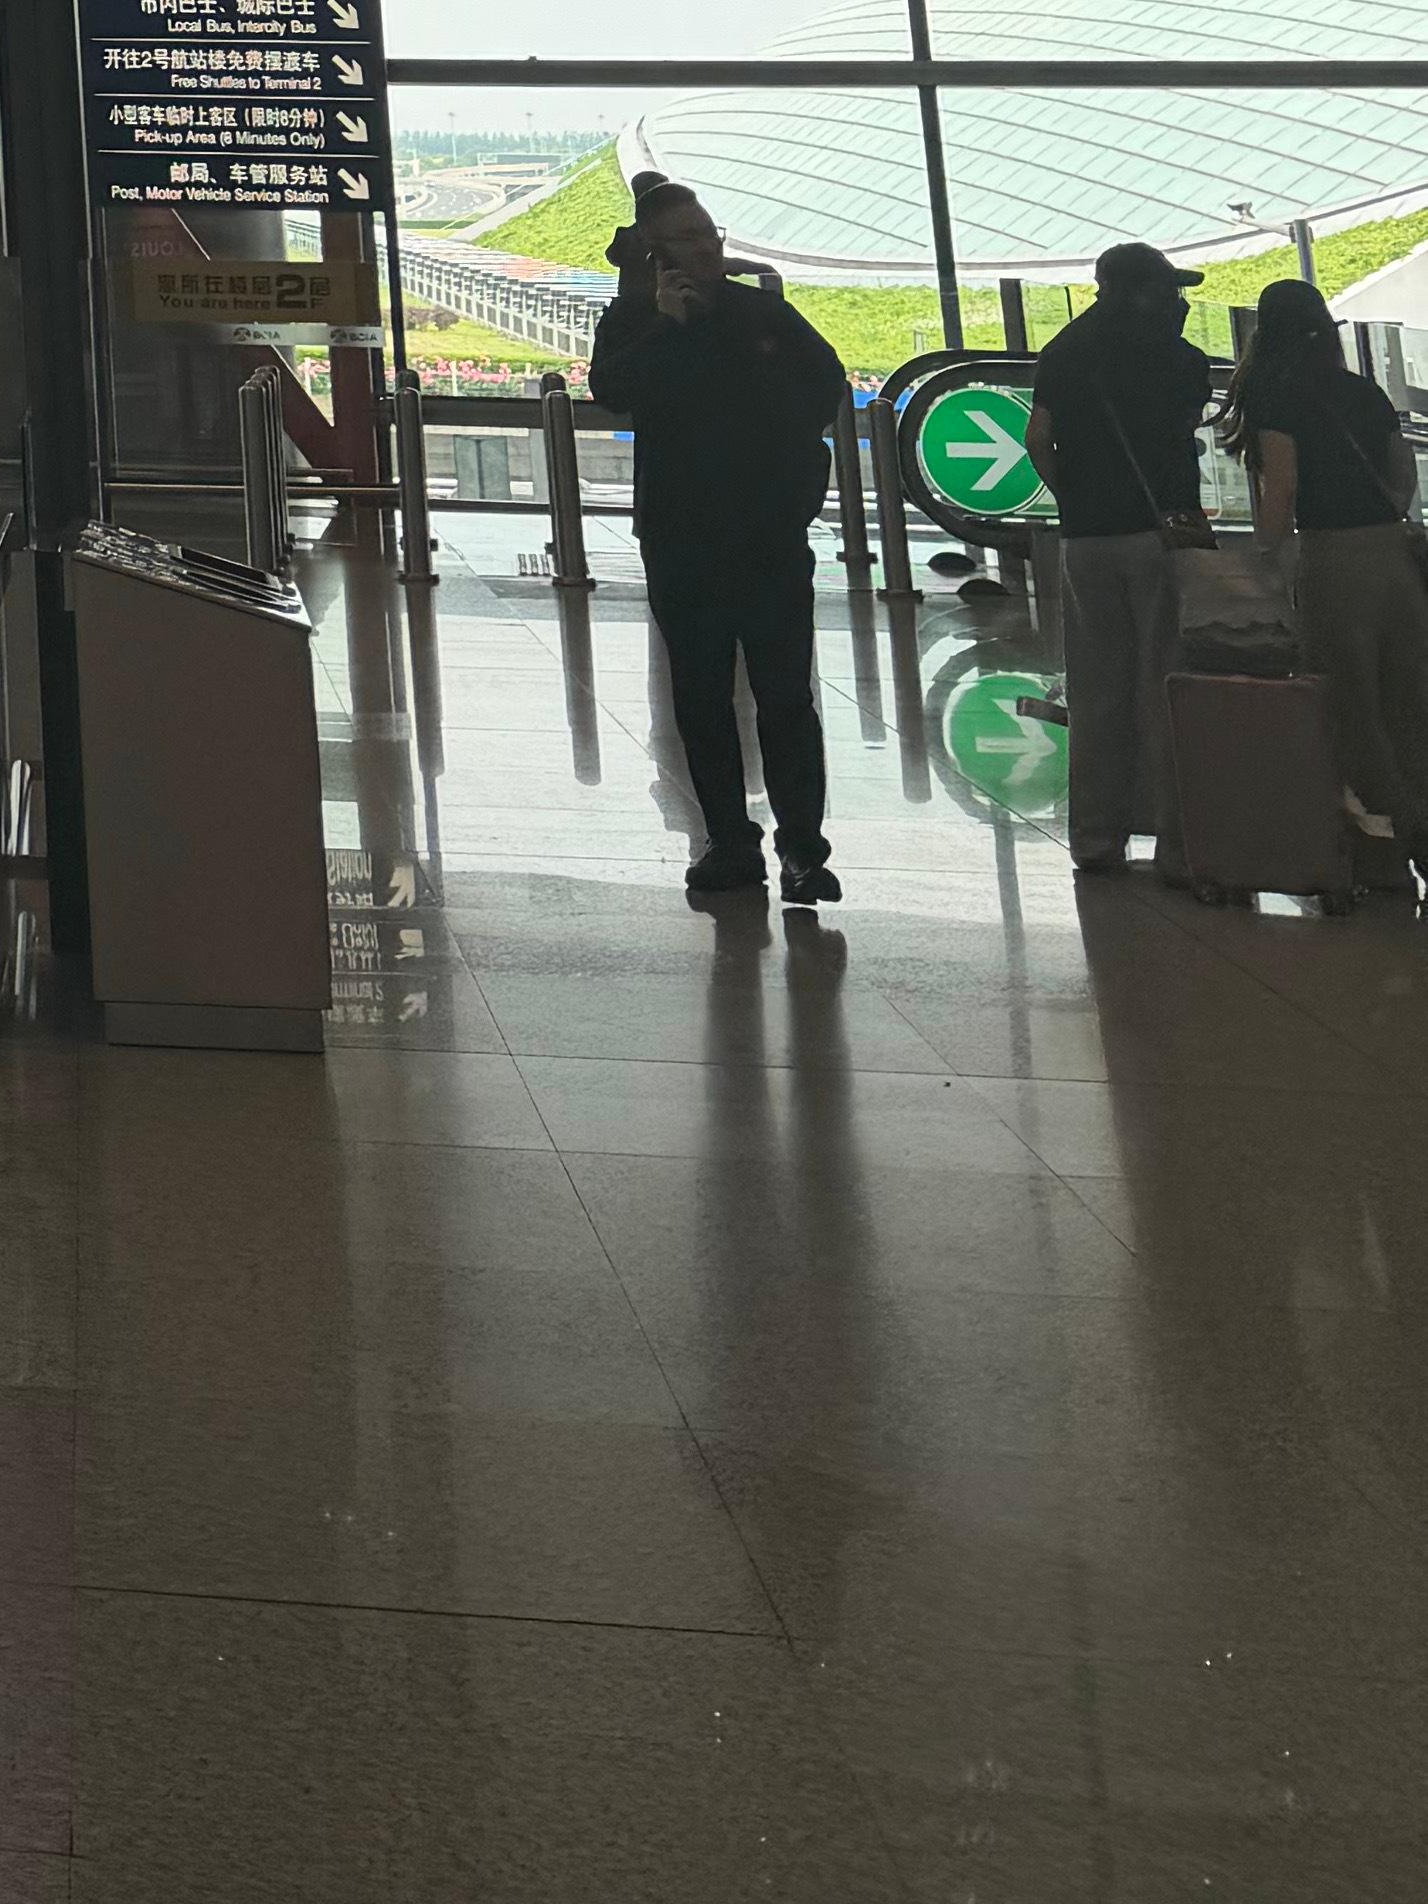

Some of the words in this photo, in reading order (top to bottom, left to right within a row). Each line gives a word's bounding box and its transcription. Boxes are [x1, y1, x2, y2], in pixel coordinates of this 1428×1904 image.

[167, 19, 202, 33] Local
[206, 19, 235, 34] Bus,
[238, 19, 286, 36] Intercity
[290, 20, 317, 34] Bus
[103, 49, 321, 72] 开往2号航站楼免费摆渡车
[171, 74, 197, 88] Free
[199, 74, 246, 90] Shuttles
[248, 76, 260, 90] to
[262, 76, 311, 90] Terminal
[312, 77, 322, 91] 2
[134, 129, 182, 145] Pick-up
[186, 130, 216, 144] Area
[235, 131, 287, 146] Minutes
[290, 132, 326, 149] Only)
[170, 162, 328, 186] 邮局、车管服务站
[111, 185, 143, 201] Post,
[146, 186, 183, 201] Motor
[186, 186, 231, 202] Vehicle
[234, 187, 281, 203] Service
[284, 188, 329, 204] Station
[276, 273, 307, 309] 2
[159, 294, 194, 309] You
[201, 296, 227, 310] are
[233, 296, 271, 310] here
